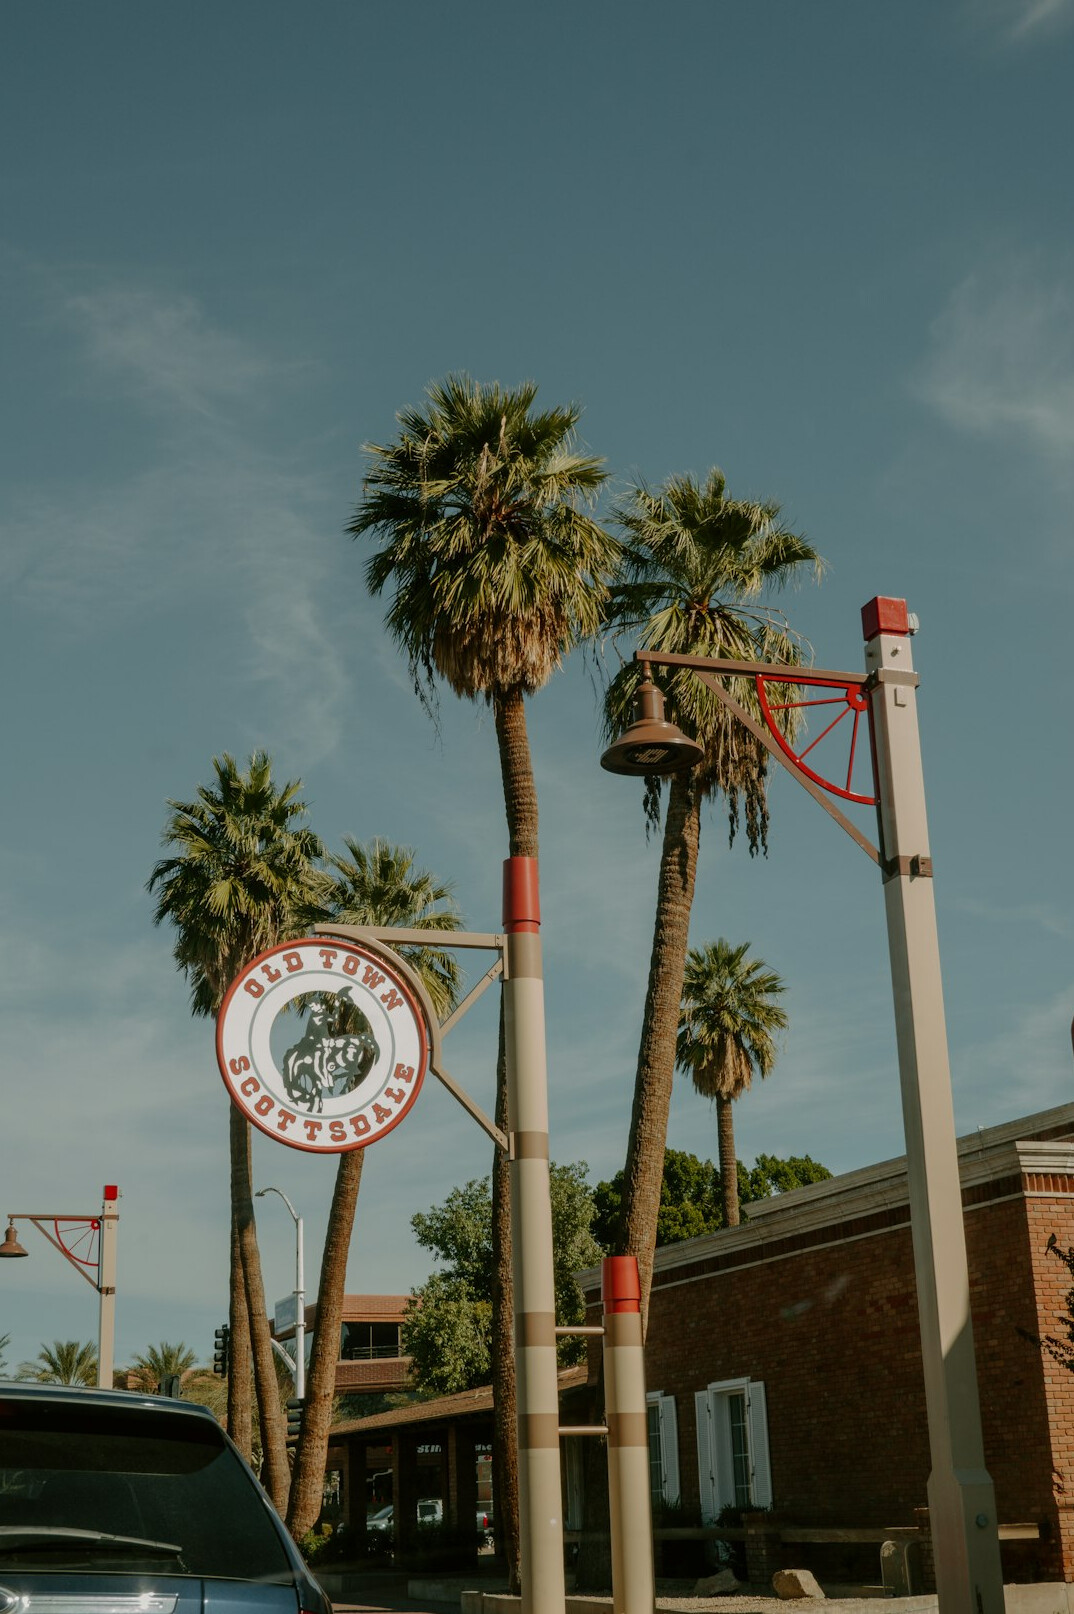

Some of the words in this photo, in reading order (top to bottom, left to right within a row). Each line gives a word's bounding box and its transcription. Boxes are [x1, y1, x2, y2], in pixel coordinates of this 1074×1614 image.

[243, 951, 304, 999] OLD
[319, 949, 404, 1012] TOWN
[229, 1055, 415, 1142] SCOTTSDALE
